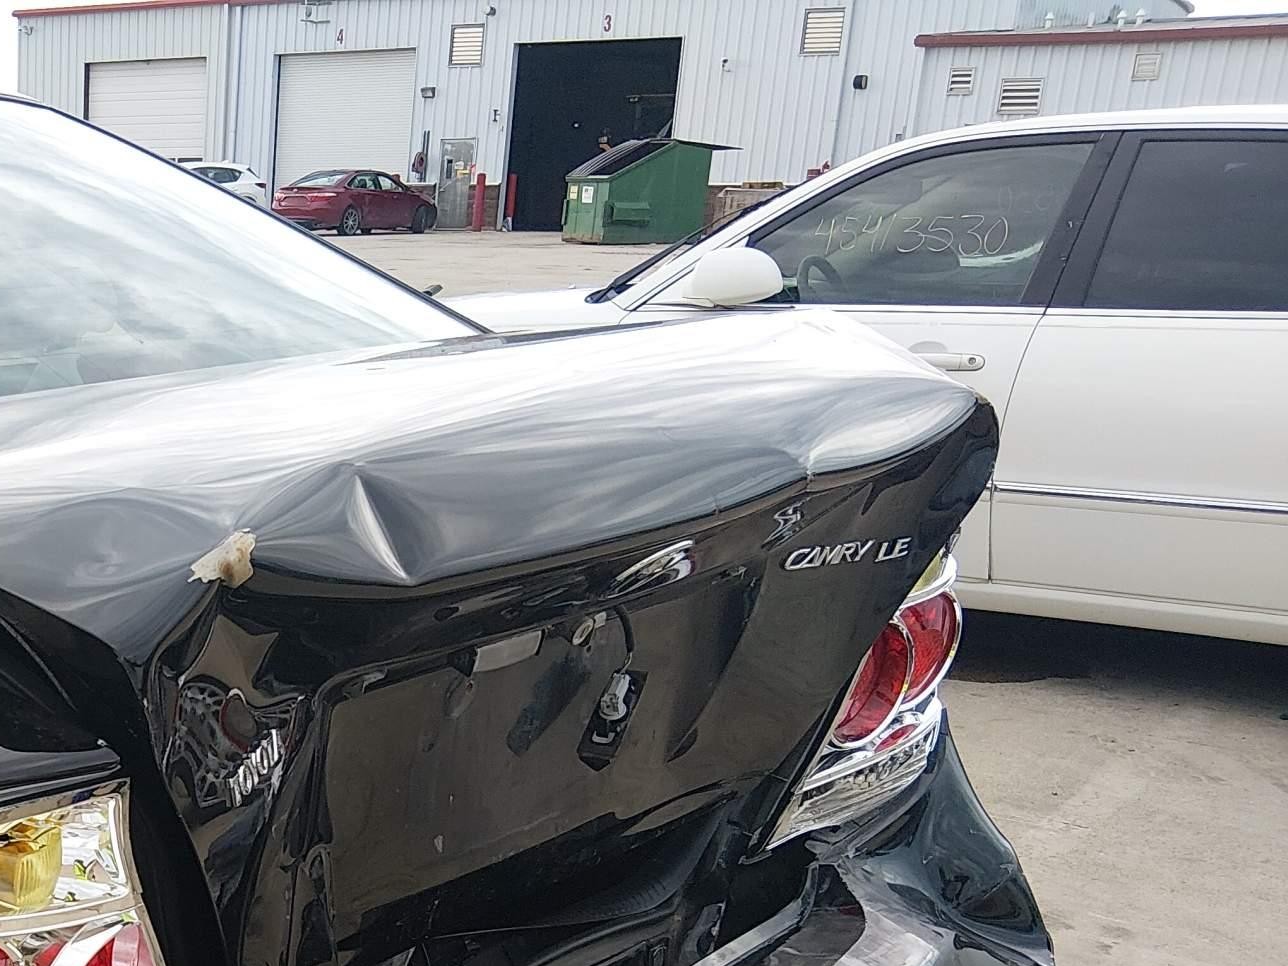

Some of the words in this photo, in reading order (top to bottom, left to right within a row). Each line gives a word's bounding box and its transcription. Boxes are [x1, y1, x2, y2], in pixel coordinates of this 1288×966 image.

[603, 14, 612, 32] 3
[336, 28, 344, 45] 4
[814, 213, 1009, 257] 45413530
[784, 539, 875, 571] CAMRY
[875, 537, 912, 563] LE
